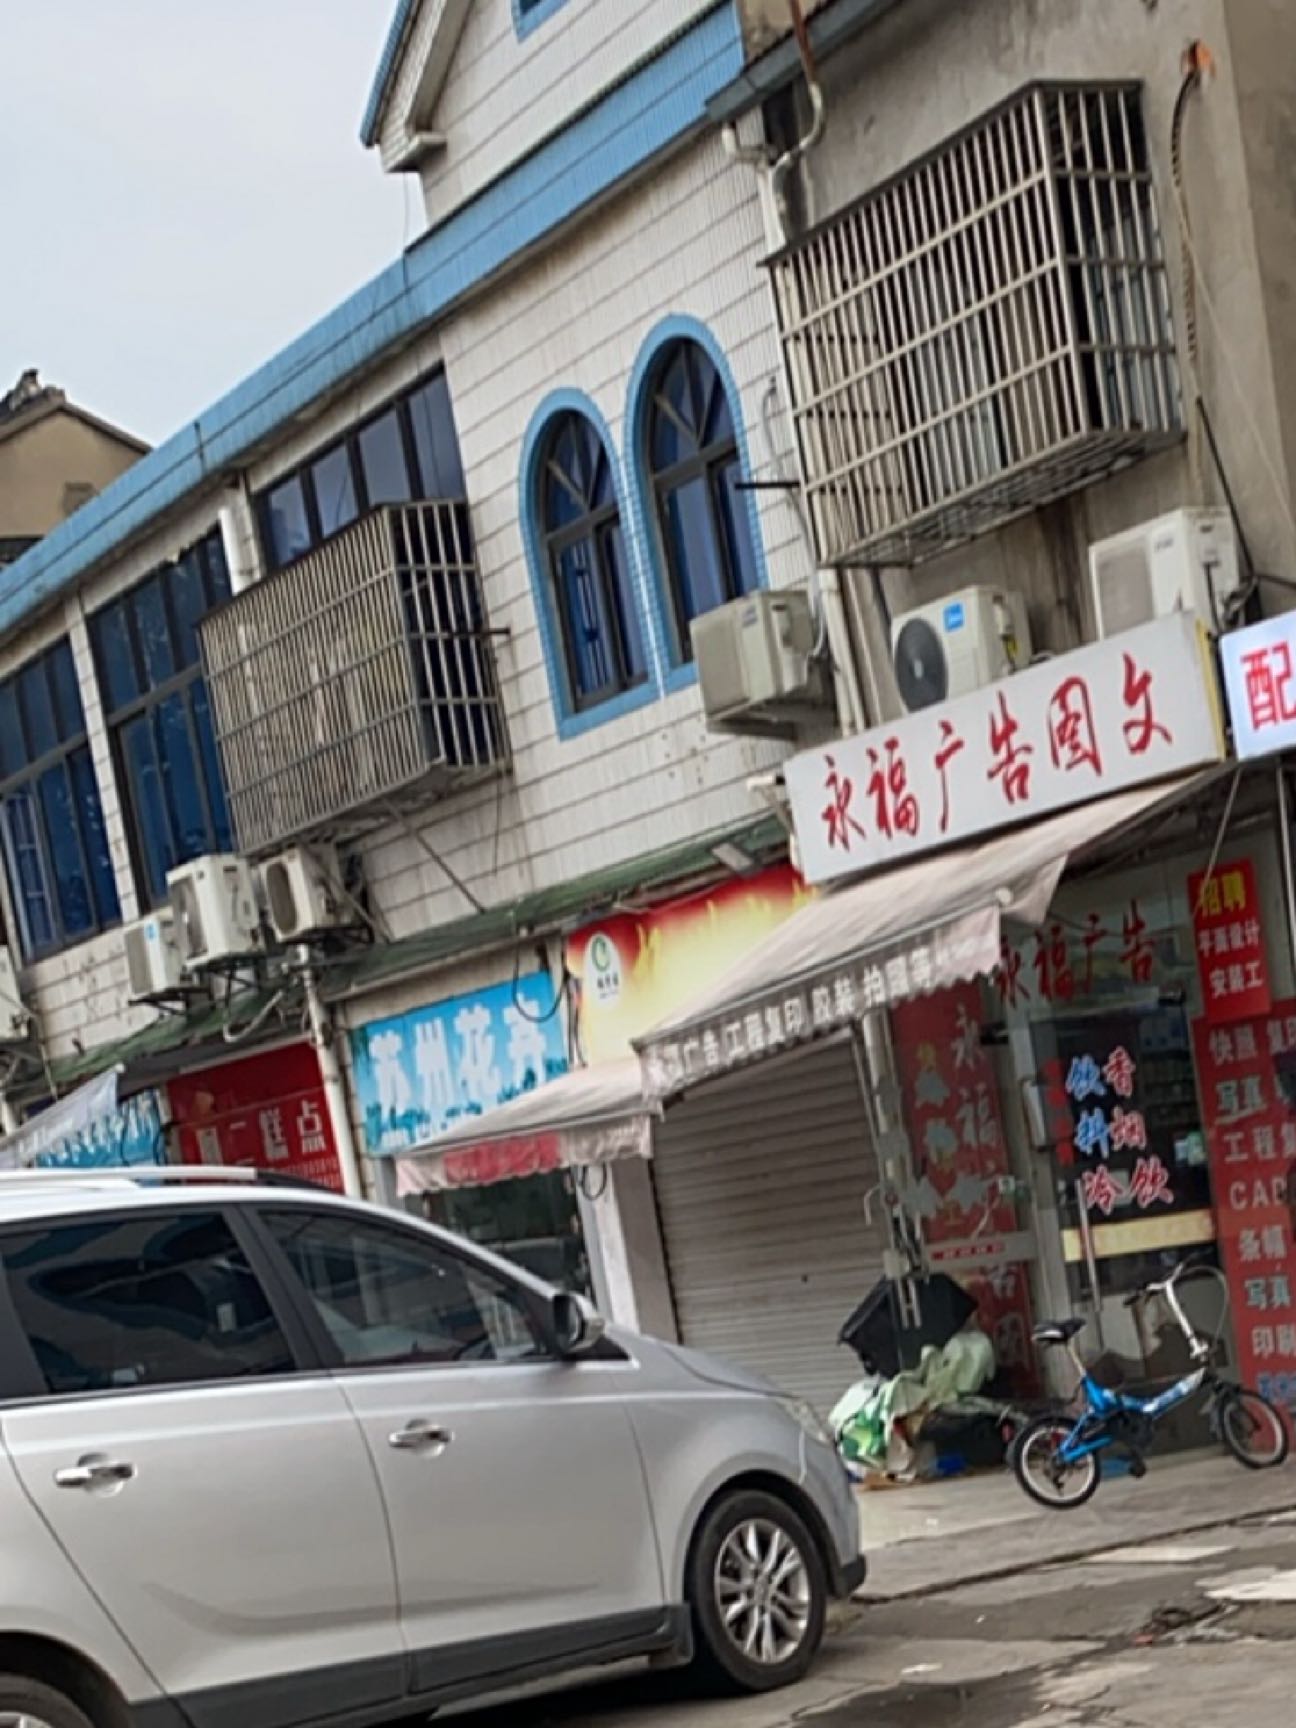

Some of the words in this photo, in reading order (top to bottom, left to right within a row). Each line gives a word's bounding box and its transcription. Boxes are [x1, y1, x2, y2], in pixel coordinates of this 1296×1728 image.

[820, 652, 1172, 851] 永福广告图文
[1199, 870, 1246, 919] 招聘
[1081, 1154, 1175, 1215] 冷饮
